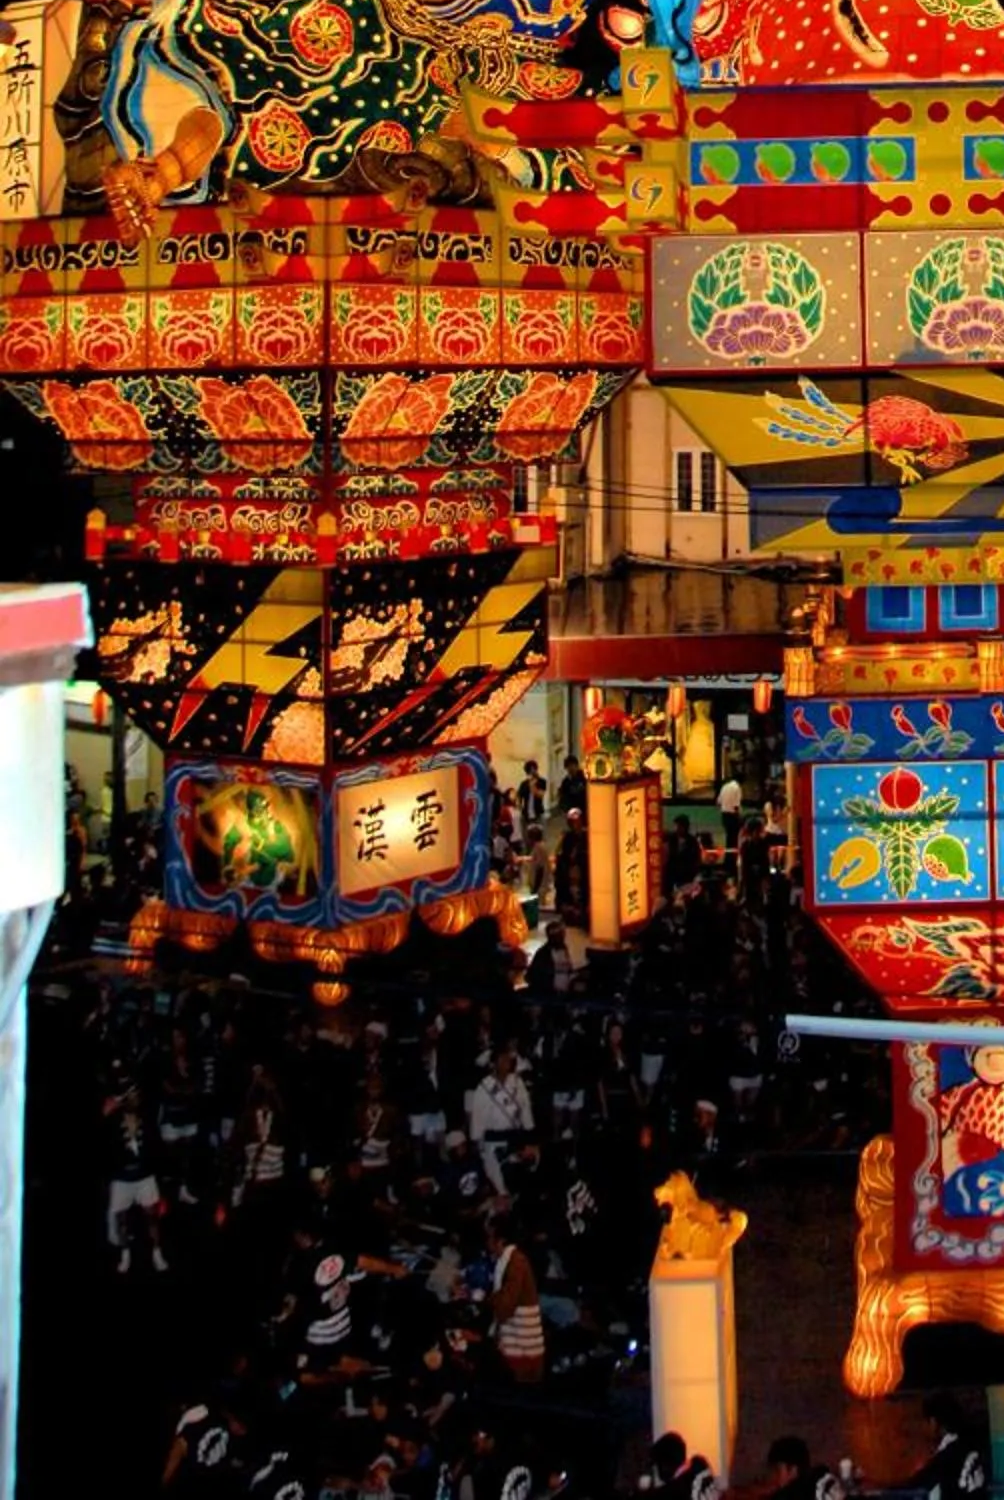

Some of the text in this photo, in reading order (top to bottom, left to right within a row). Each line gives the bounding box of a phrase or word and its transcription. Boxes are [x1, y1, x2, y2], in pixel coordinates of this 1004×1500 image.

[4, 39, 36, 213] 五所川原市
